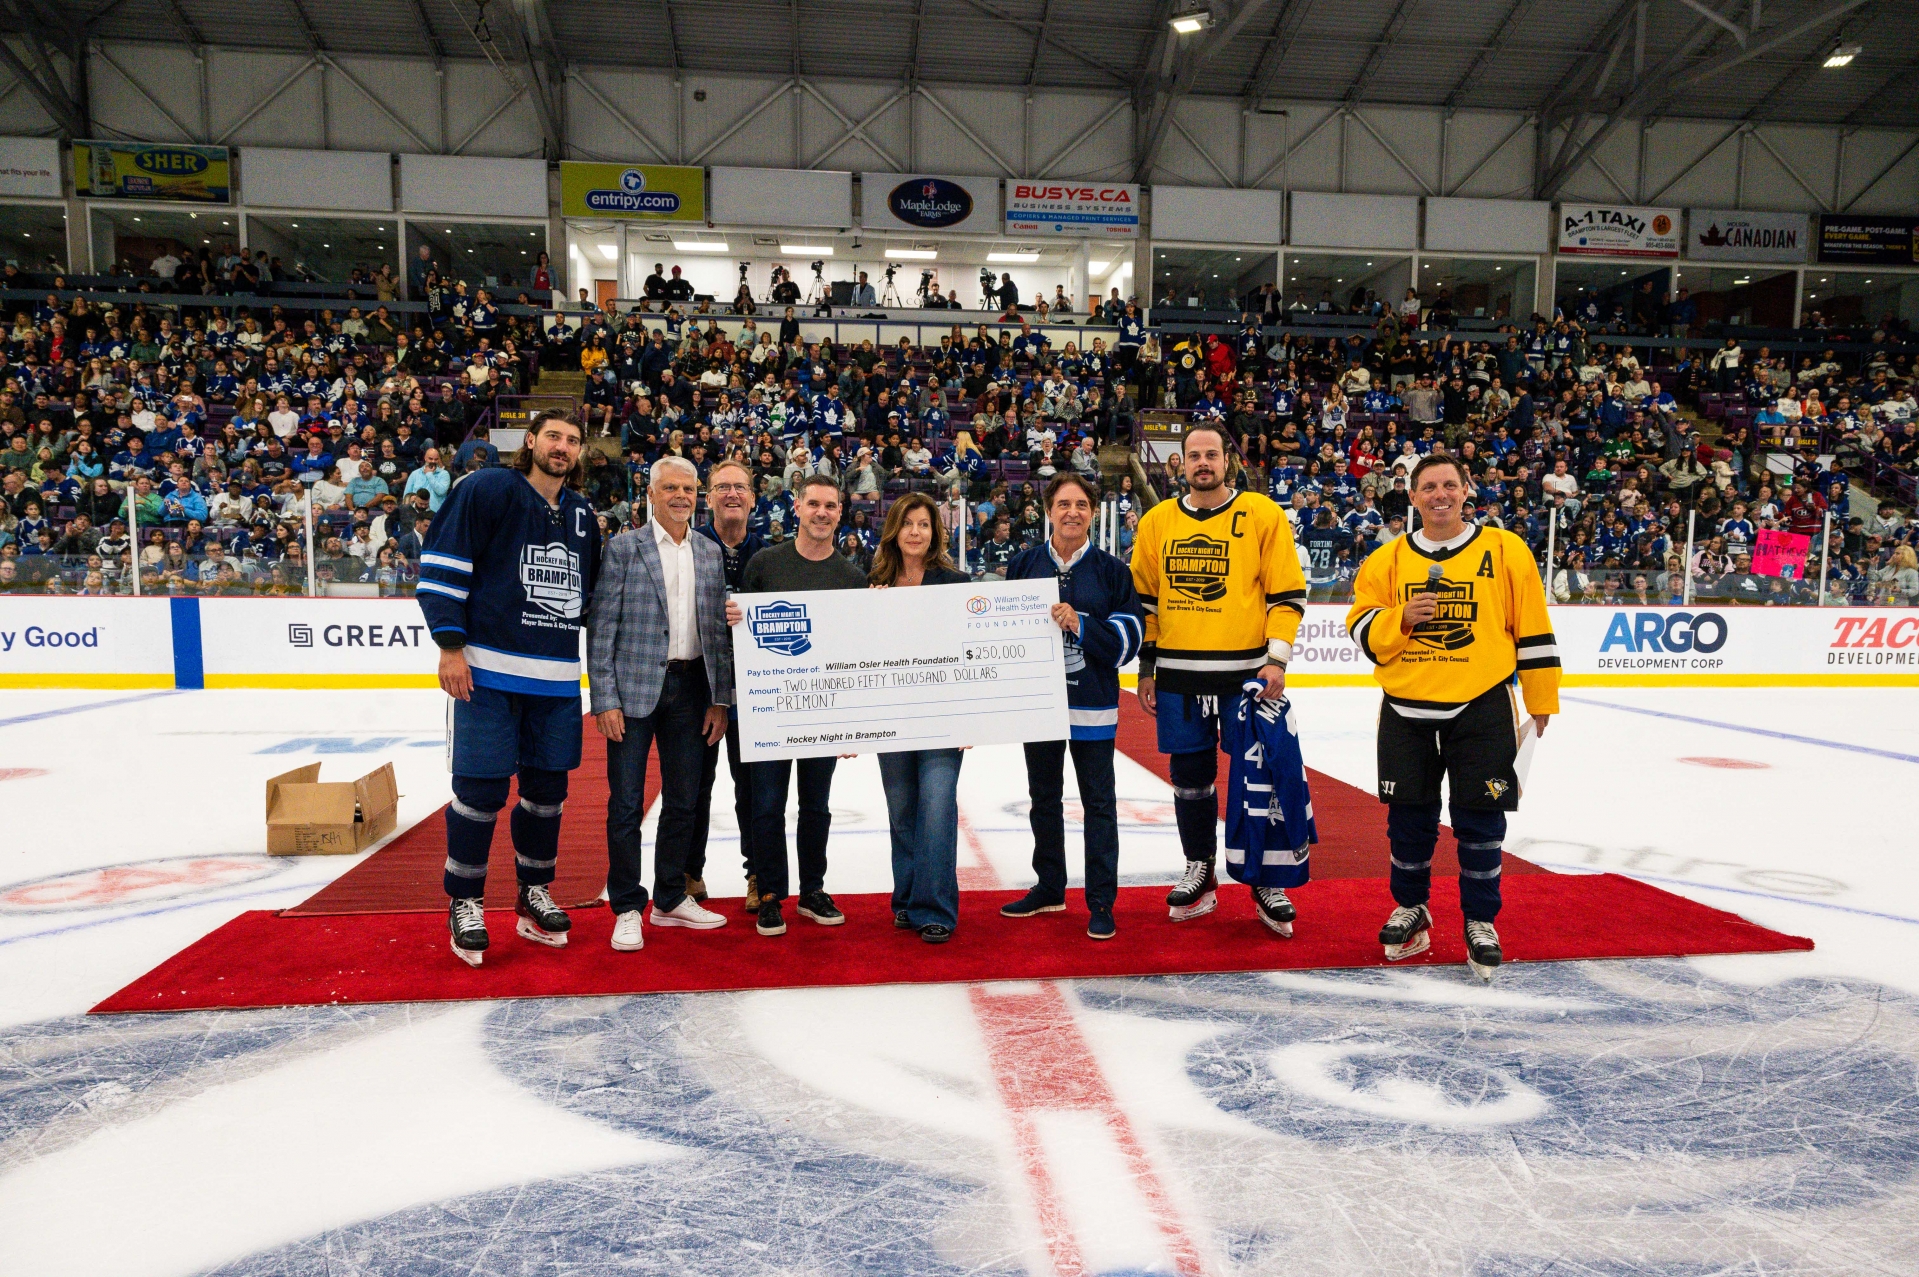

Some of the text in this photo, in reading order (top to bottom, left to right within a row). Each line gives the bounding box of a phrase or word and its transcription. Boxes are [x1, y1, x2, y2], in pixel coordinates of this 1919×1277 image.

[142, 153, 198, 171] SHER
[591, 193, 675, 209] entripy.com
[1015, 185, 1131, 202] BUSYS.CA
[920, 211, 941, 219] FARMS
[1013, 202, 1131, 213] BUSINESS SYSTEMS
[1565, 210, 1646, 234] A-1 TAXI
[1601, 225, 1624, 235] LARGEST
[1623, 229, 1640, 240] FLEET
[1725, 228, 1796, 248] CANADIAN
[500, 411, 526, 419] AISLE 3R
[1143, 423, 1158, 431] AISLE
[1797, 438, 1811, 446] AISLE
[575, 507, 586, 537] C
[1231, 511, 1247, 538] C
[536, 556, 557, 564] HOCKEY
[1170, 559, 1226, 573] BRAMPTON
[1310, 549, 1331, 569] 78
[1477, 550, 1494, 578] A
[528, 568, 580, 588] BRAMPTON
[994, 596, 1019, 604] William
[996, 602, 1048, 612] Health System
[538, 620, 553, 628] Brown
[559, 622, 567, 630] City
[756, 621, 808, 634] BRAMPTON
[968, 618, 1049, 629] FOUNDATION
[1296, 620, 1348, 643] apita
[323, 624, 424, 648] GREAT
[1599, 612, 1728, 653] ARGO
[1830, 617, 1919, 648] TAC
[1290, 643, 1361, 662] Power
[1827, 652, 1919, 664] DEVELOPME
[747, 669, 761, 677] Pay
[825, 662, 857, 670] William
[859, 660, 881, 668] Osler
[883, 658, 910, 667] Health
[912, 655, 959, 665] Foundation
[1598, 658, 1724, 669] DEVELOPMENT CORP
[749, 667, 998, 695] Amount: TWO HUNDRED FIFTY THOUSAND DOLLARS
[752, 693, 837, 713] From: PRIMONT
[786, 736, 817, 744] Hockey
[819, 734, 843, 743] Night
[845, 732, 853, 740] in
[855, 730, 897, 740] Brampton
[1244, 740, 1264, 769] 4
